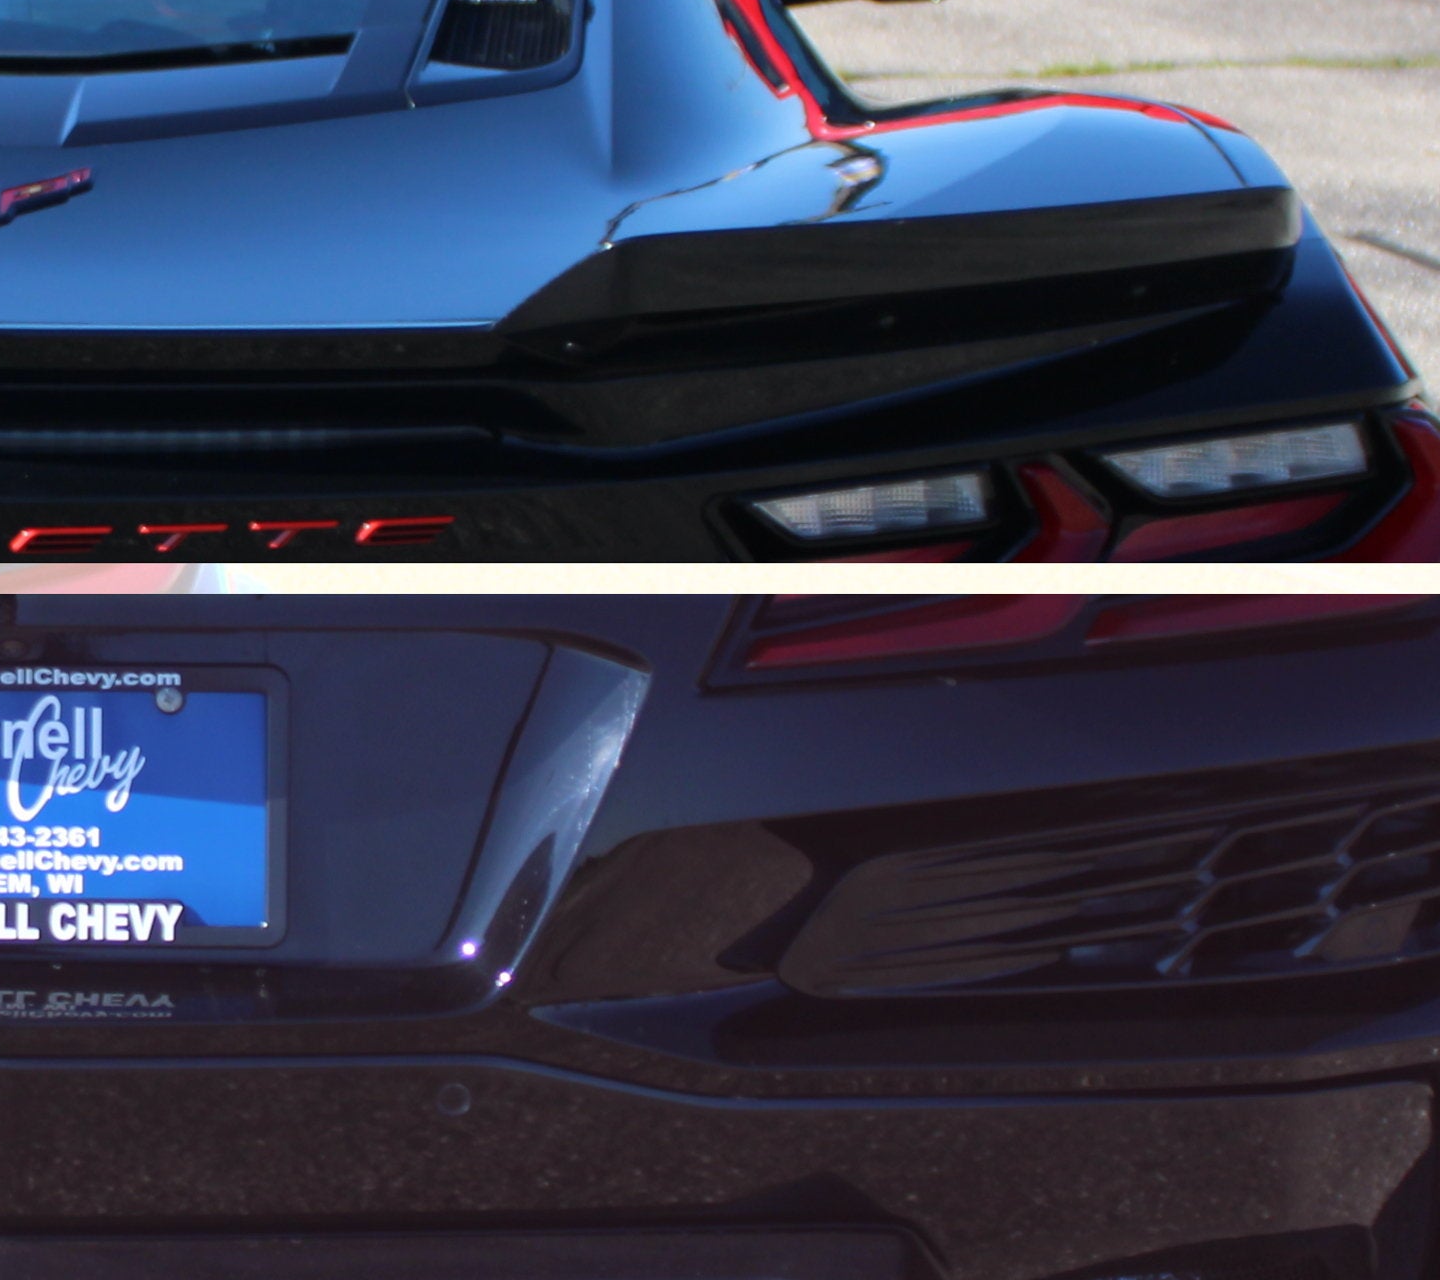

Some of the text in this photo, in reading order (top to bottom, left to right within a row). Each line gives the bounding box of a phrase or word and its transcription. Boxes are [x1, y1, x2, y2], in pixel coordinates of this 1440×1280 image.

[7, 694, 146, 822] Chevy
[46, 873, 84, 894] WI
[48, 902, 184, 942] CHEVY
